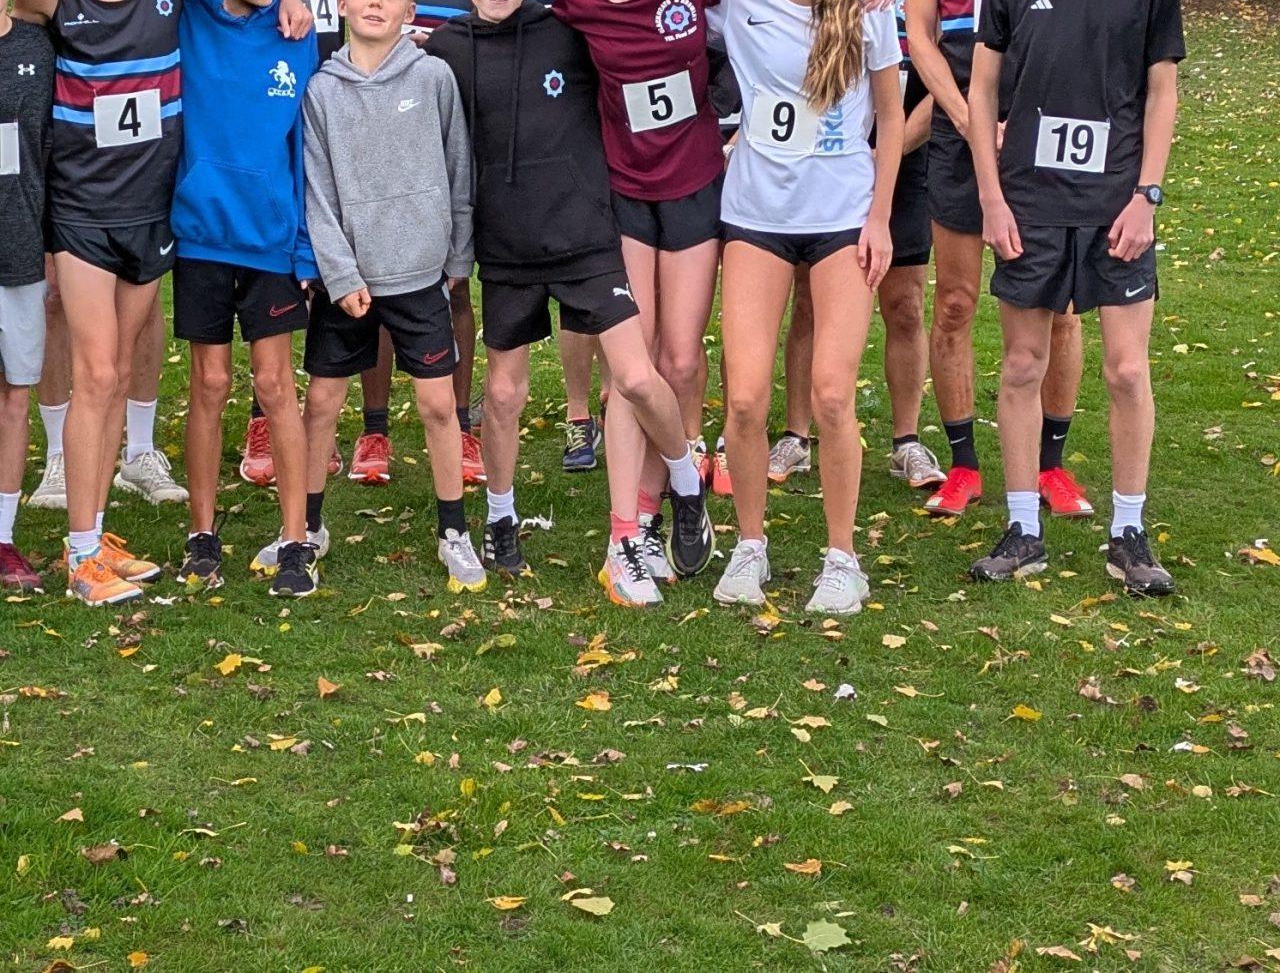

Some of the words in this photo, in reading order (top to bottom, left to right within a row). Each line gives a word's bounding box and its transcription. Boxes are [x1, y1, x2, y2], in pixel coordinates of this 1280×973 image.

[118, 97, 141, 137] 4
[647, 82, 673, 122] 5
[771, 101, 796, 142] 9
[1051, 122, 1094, 165] 19
